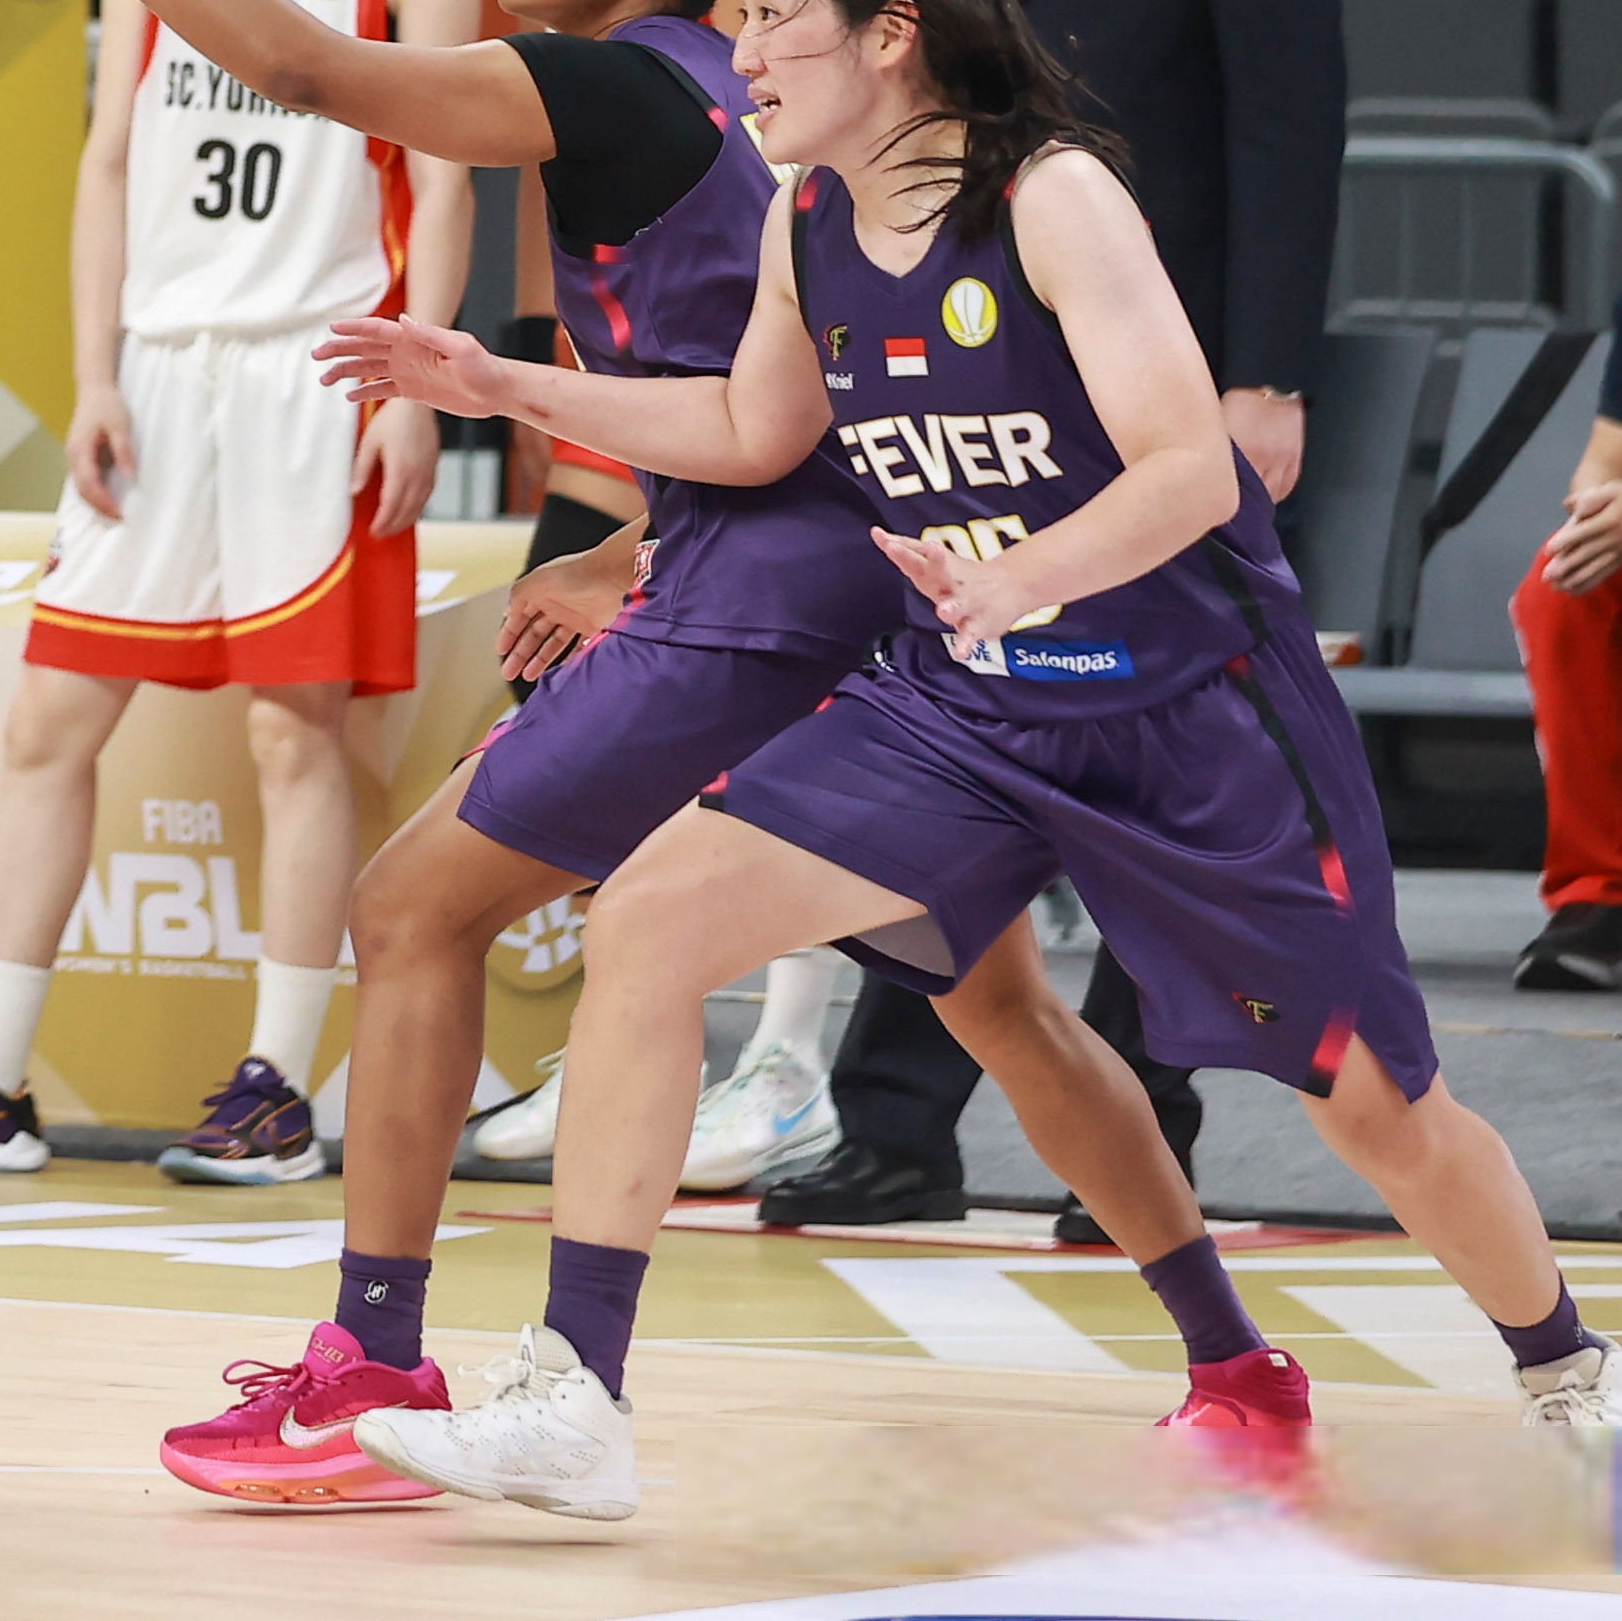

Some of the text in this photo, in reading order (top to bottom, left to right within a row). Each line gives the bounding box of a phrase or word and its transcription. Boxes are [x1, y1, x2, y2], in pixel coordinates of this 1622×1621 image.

[165, 61, 331, 123] SC.YU
[193, 139, 283, 221] 30
[1014, 647, 1118, 675] Salonpas
[141, 798, 224, 845] FIBA
[58, 851, 357, 966] WBL
